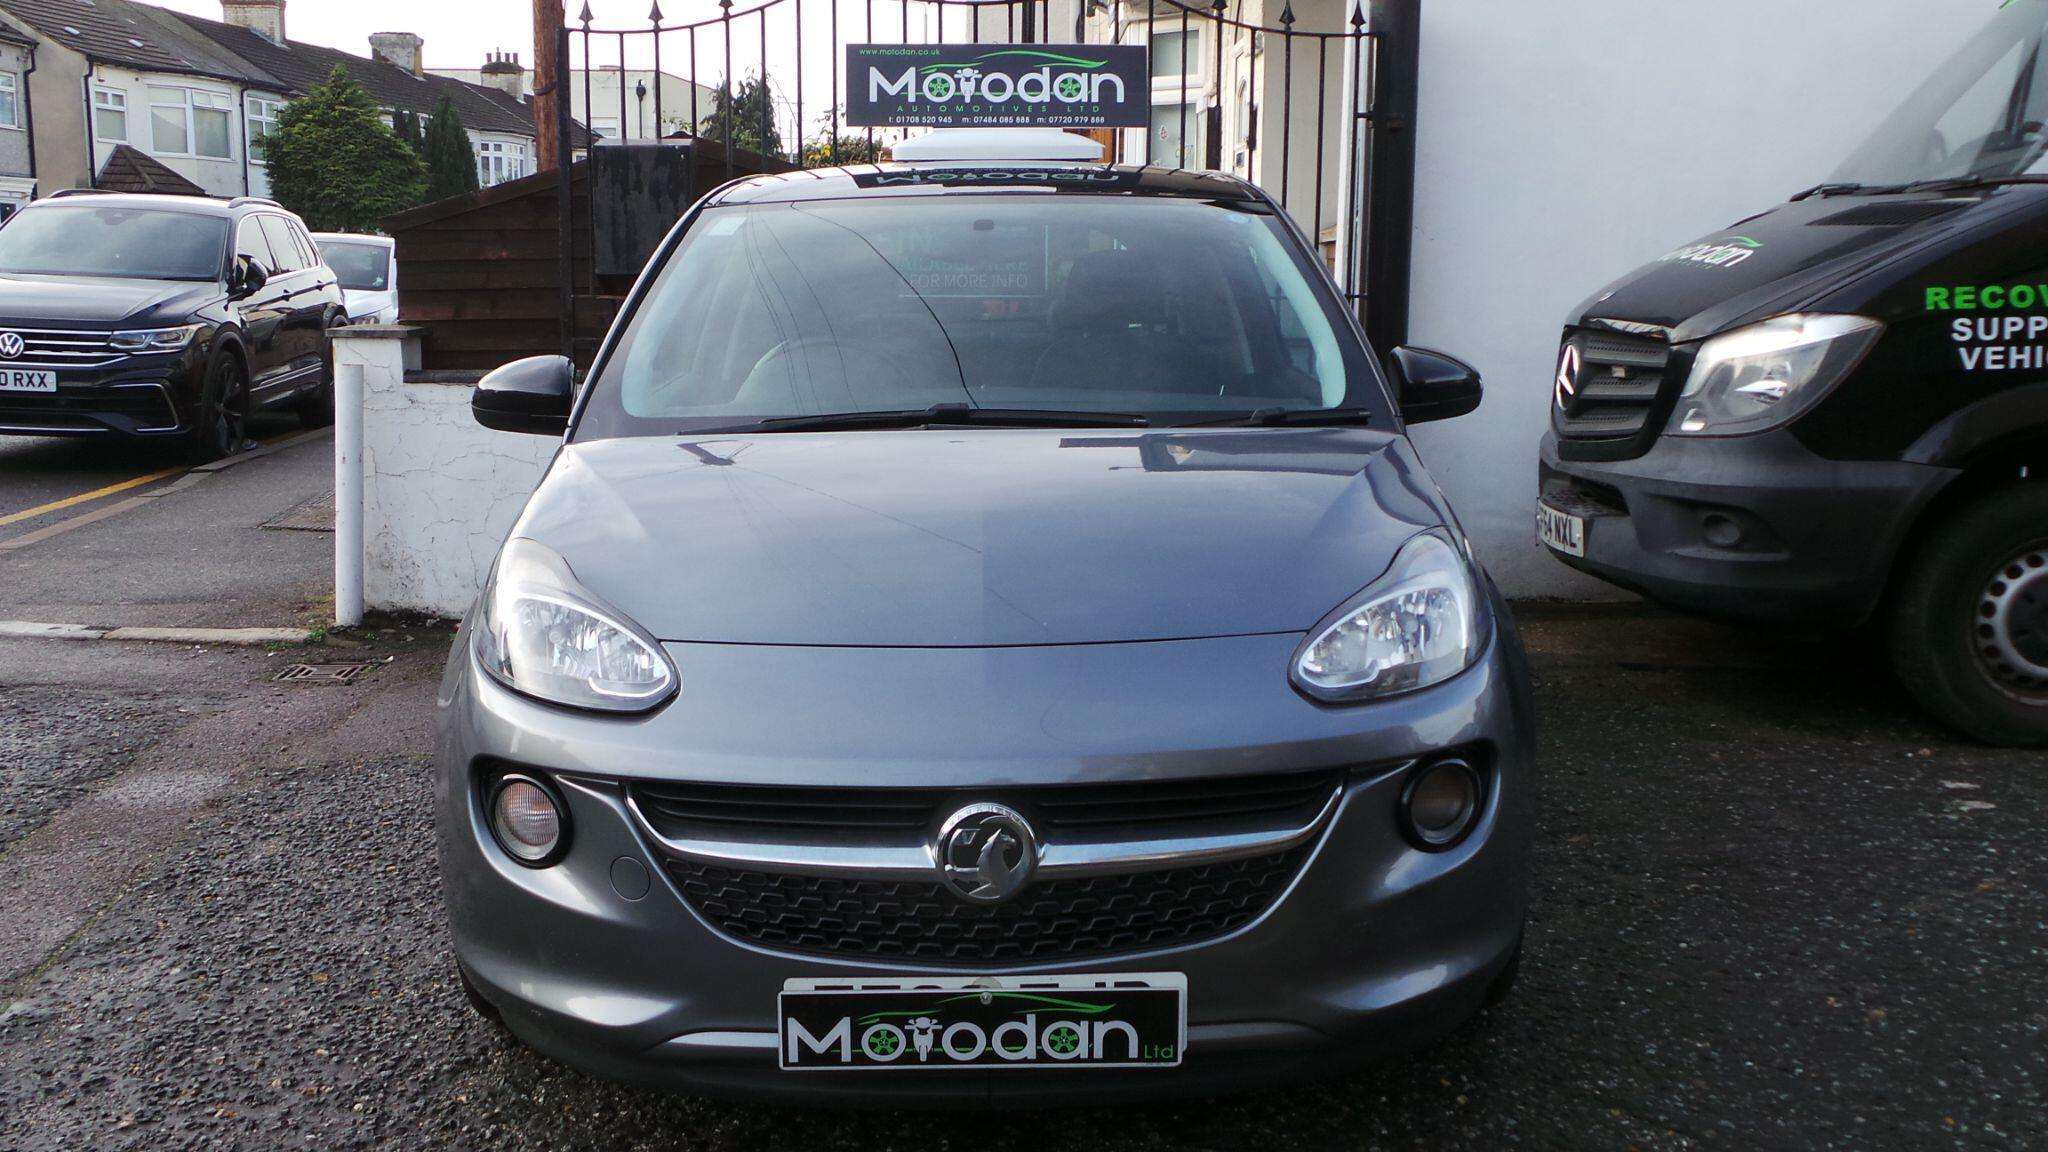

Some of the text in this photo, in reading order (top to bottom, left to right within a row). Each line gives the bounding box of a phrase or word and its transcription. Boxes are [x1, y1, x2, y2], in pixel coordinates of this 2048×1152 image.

[896, 105, 1100, 113] AUTOMOTIVES LTD
[896, 115, 920, 124] 01708
[922, 115, 936, 124] 520
[938, 115, 953, 124] 945
[1048, 115, 1072, 124] 07720
[944, 273, 987, 288] MORE
[991, 273, 1028, 288] INFO
[1951, 316, 2048, 341] SUPP
[1959, 346, 2048, 370] VEHI
[14, 372, 48, 388] RXX
[1554, 513, 1578, 548] NXL
[1143, 1044, 1174, 1060] Ltd
